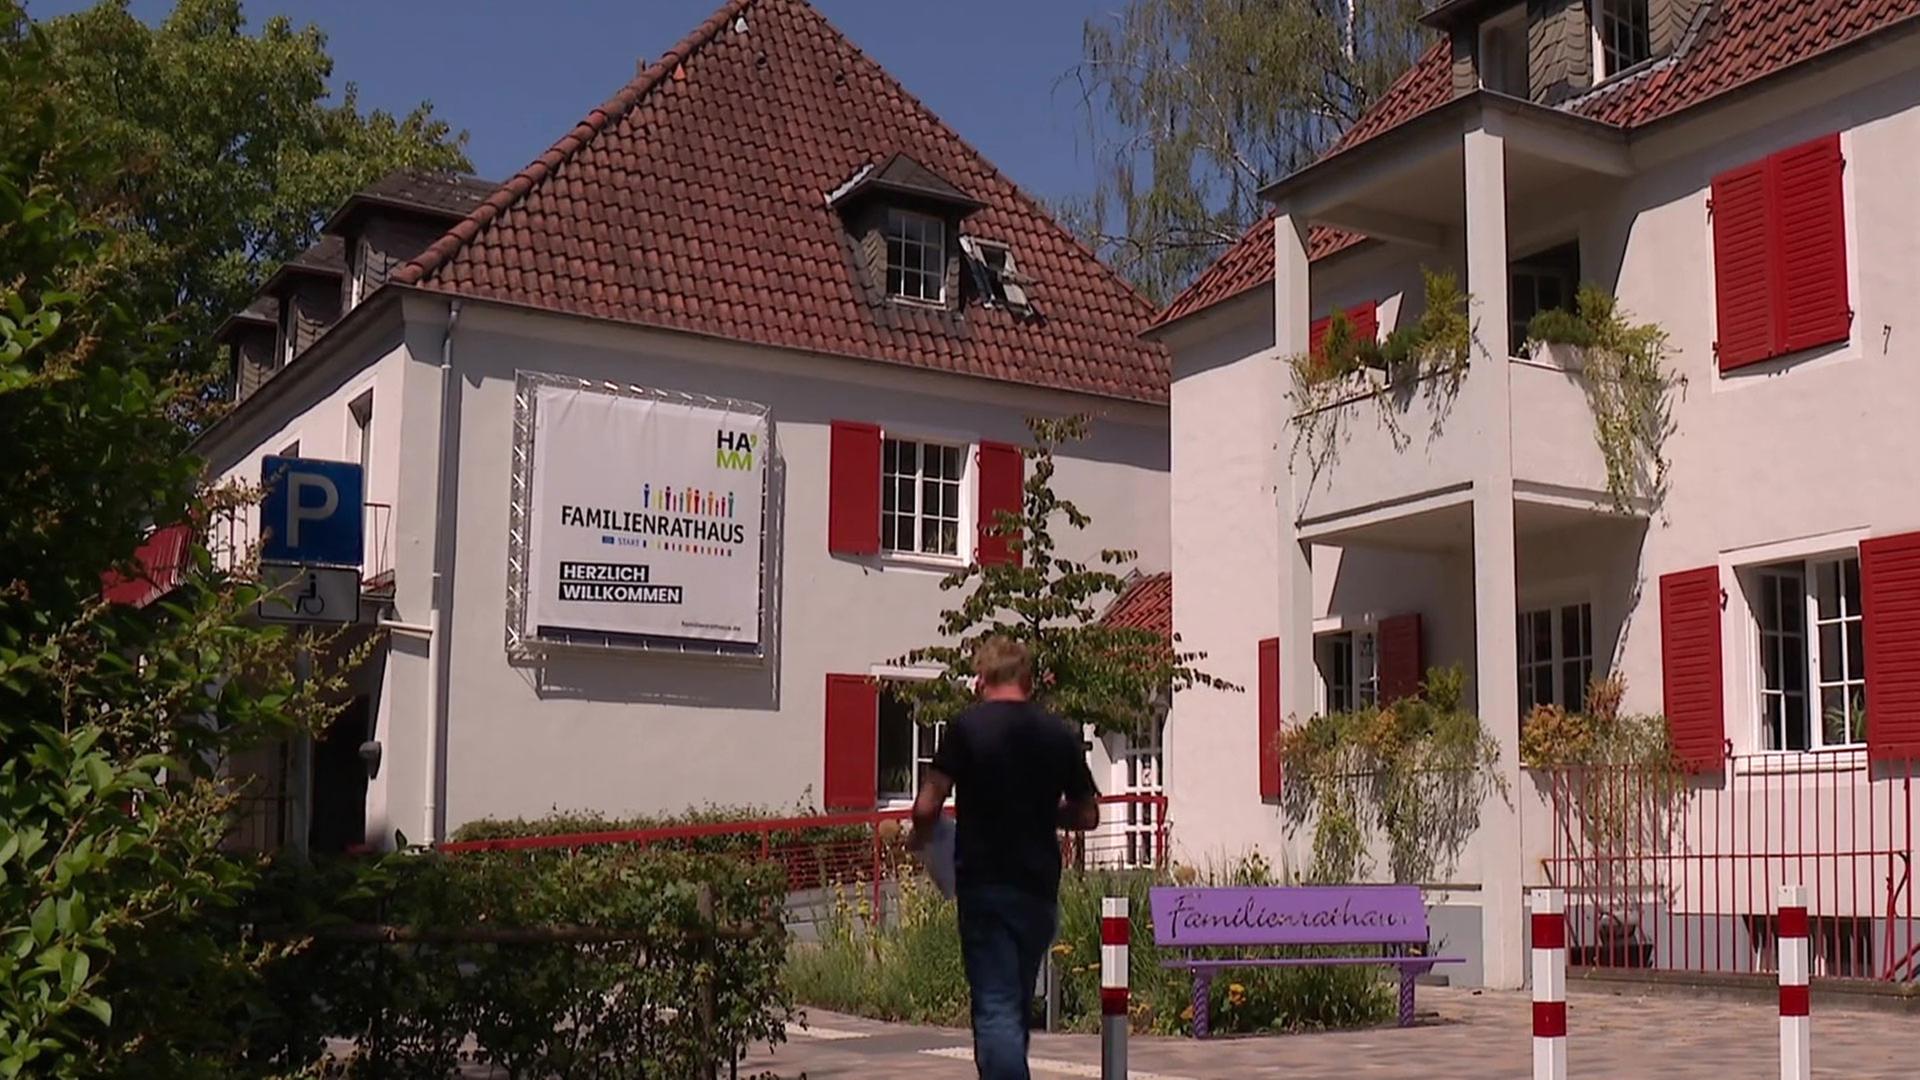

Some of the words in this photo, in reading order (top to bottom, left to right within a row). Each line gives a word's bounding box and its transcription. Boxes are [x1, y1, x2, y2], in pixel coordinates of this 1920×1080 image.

[286, 472, 339, 548] P
[561, 505, 744, 544] FAMILIENRATHAUS
[563, 564, 646, 581] HERZLICH
[563, 584, 680, 603] WILLKOMMEN
